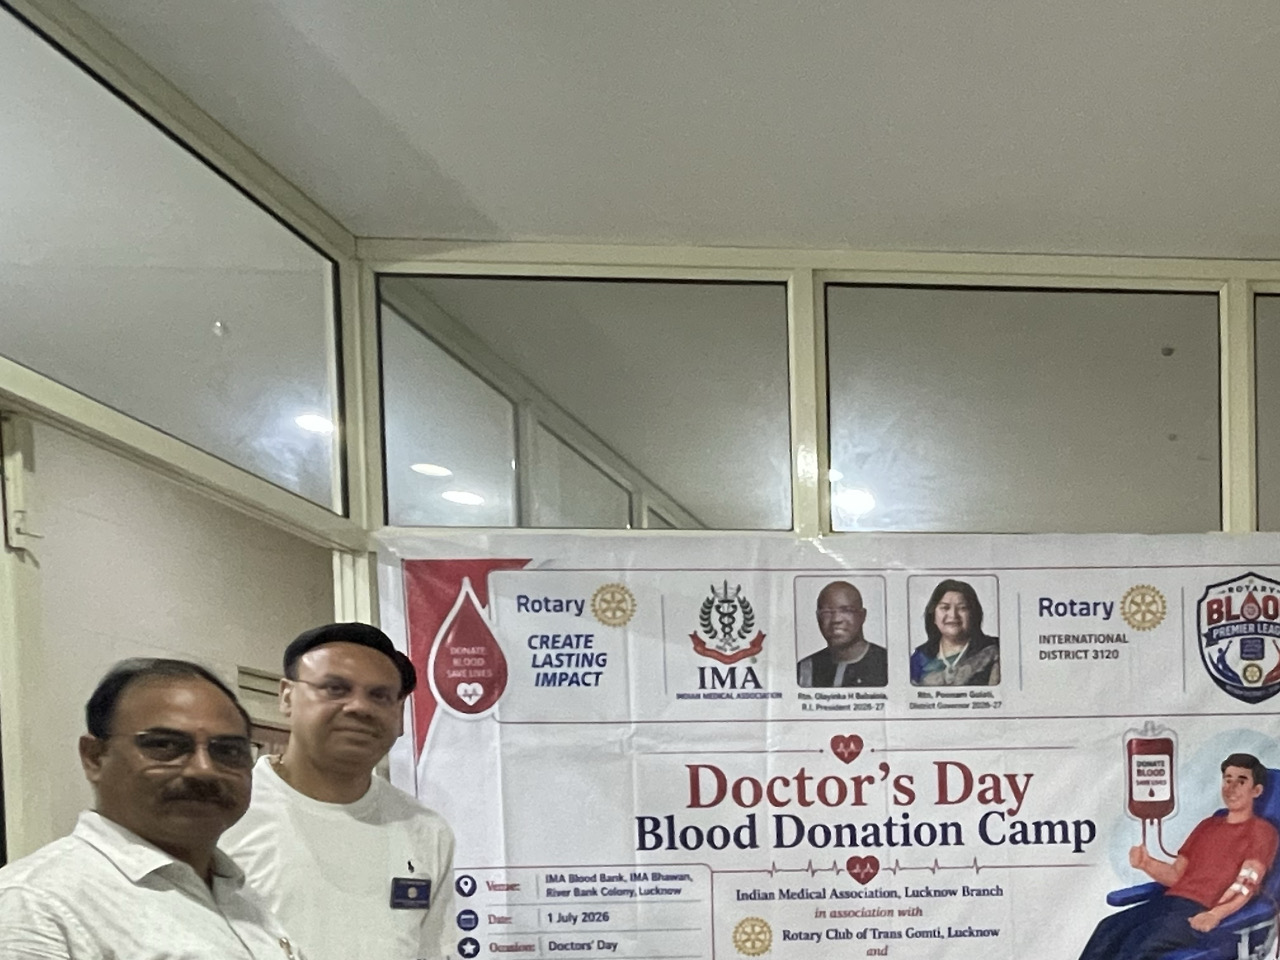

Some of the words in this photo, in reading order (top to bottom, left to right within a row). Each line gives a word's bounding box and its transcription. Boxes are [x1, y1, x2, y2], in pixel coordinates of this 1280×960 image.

[1228, 585, 1275, 594] ROTARY
[517, 595, 585, 617] Rotary
[1038, 598, 1114, 620] Rotary
[1212, 623, 1255, 639] PREMIER
[527, 634, 594, 650] CREATE
[1038, 633, 1129, 645] INTERNATIONAL
[531, 652, 607, 669] LASTING
[1038, 648, 1089, 660] DISTRICT
[1092, 648, 1119, 660] 3120
[534, 671, 603, 688] IMPACT
[698, 666, 763, 690] IMA
[685, 762, 915, 809] Doctor’s
[934, 760, 1034, 817] Day
[636, 813, 759, 851] Blood
[773, 811, 965, 849] Donation
[978, 811, 1096, 854] Camp
[545, 874, 566, 884] IMA
[568, 873, 597, 884] Blood
[573, 886, 598, 897] Bank
[639, 885, 682, 896] Lucknow
[736, 888, 775, 900] Indian
[778, 887, 826, 899] Medical
[829, 887, 901, 900] Association,
[904, 886, 958, 898] Lucknow
[962, 886, 1003, 897] Branch
[547, 913, 553, 923] 1
[556, 912, 578, 924] July
[581, 911, 610, 922] 2026
[814, 907, 827, 918] in
[830, 907, 894, 918] association
[898, 906, 923, 917] with
[782, 929, 822, 944] Rotary
[825, 928, 853, 940] Club
[856, 928, 869, 940] of
[870, 928, 902, 940] Trans
[905, 927, 944, 940] Gomti,
[947, 926, 1000, 938] Lucknow
[597, 940, 618, 952] Day
[866, 945, 889, 956] and
